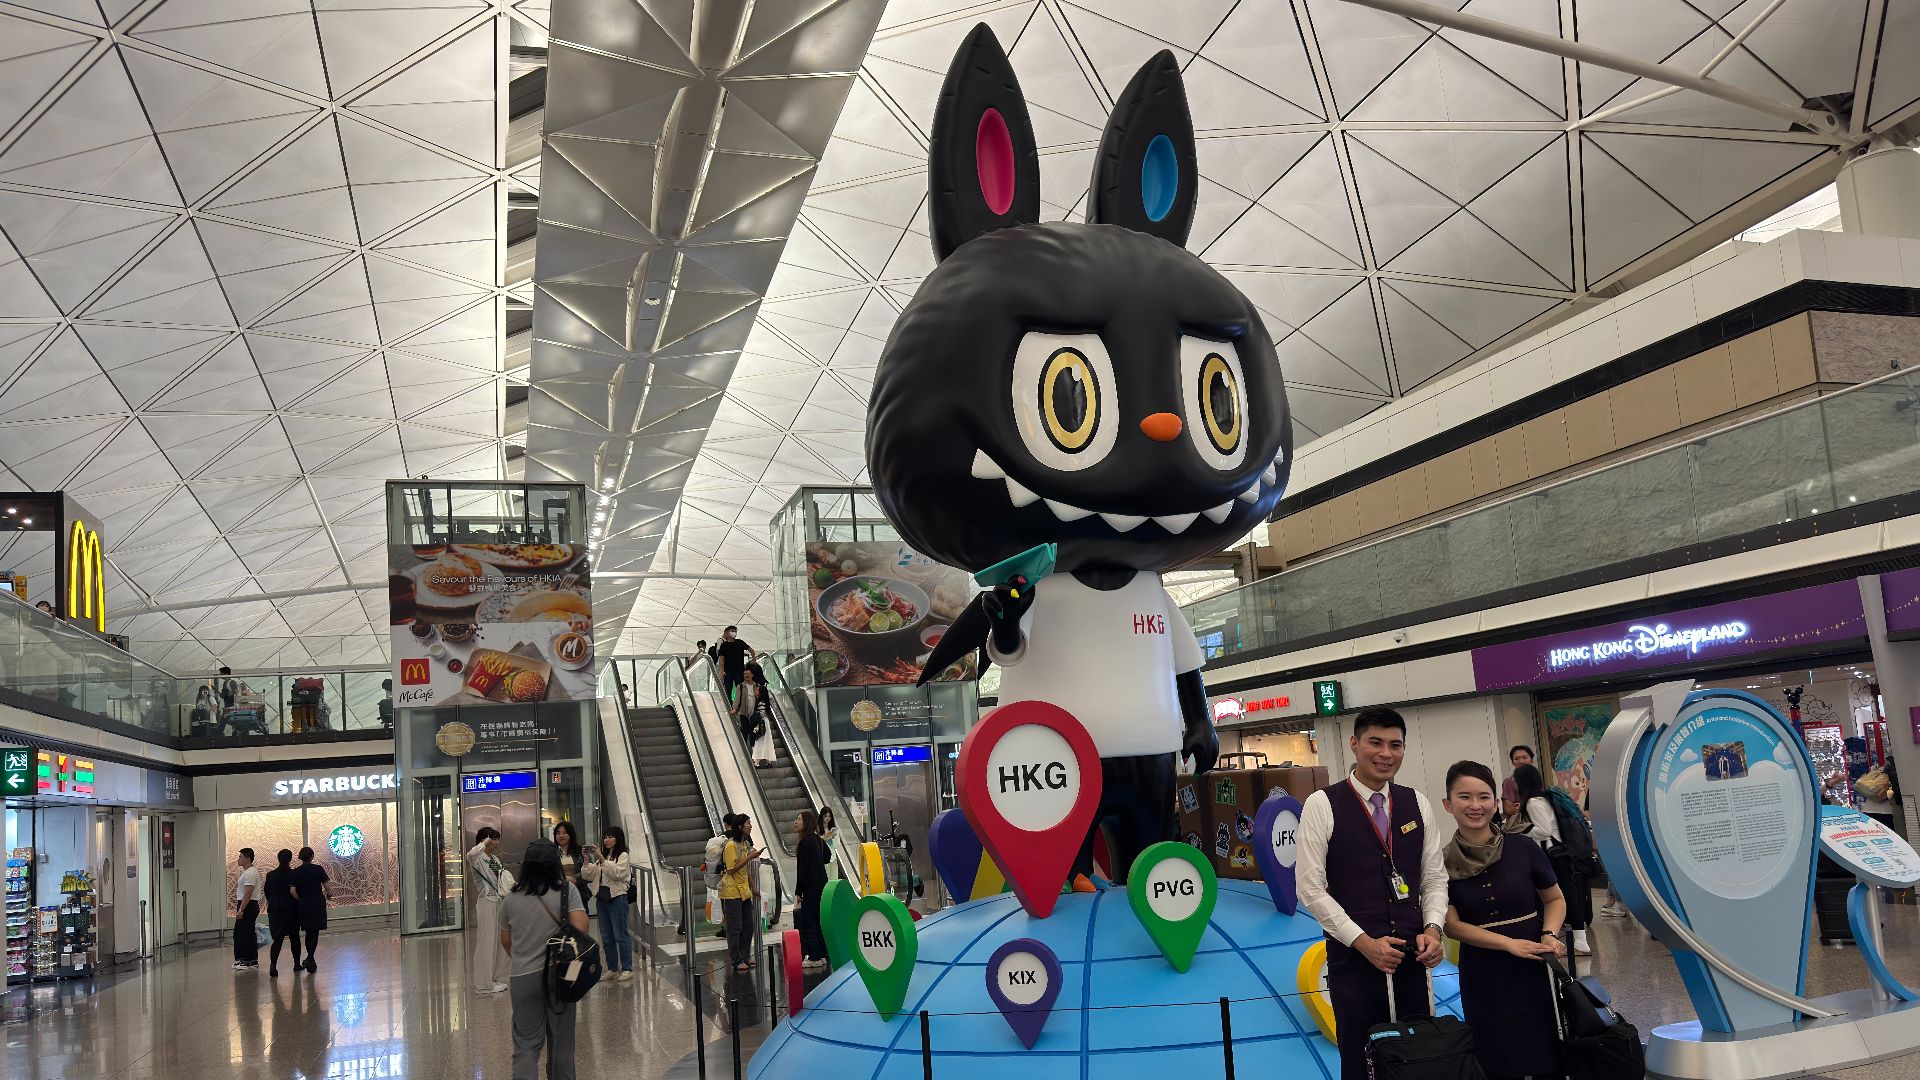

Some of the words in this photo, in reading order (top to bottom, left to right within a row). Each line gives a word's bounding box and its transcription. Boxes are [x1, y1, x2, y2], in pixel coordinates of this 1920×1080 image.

[431, 574, 467, 584] Savour
[469, 574, 486, 583] the
[487, 574, 526, 583] Flavours
[527, 574, 538, 583] of
[539, 573, 562, 582] HKIA
[1551, 646, 1589, 667] HONG
[1593, 639, 1633, 660] KONG
[275, 773, 396, 796] STARBUCK
[998, 761, 1068, 794] HKG
[1275, 829, 1297, 848] JFK
[1153, 878, 1195, 899] PVG
[861, 930, 894, 948] BKK
[1008, 970, 1037, 986] KIX
